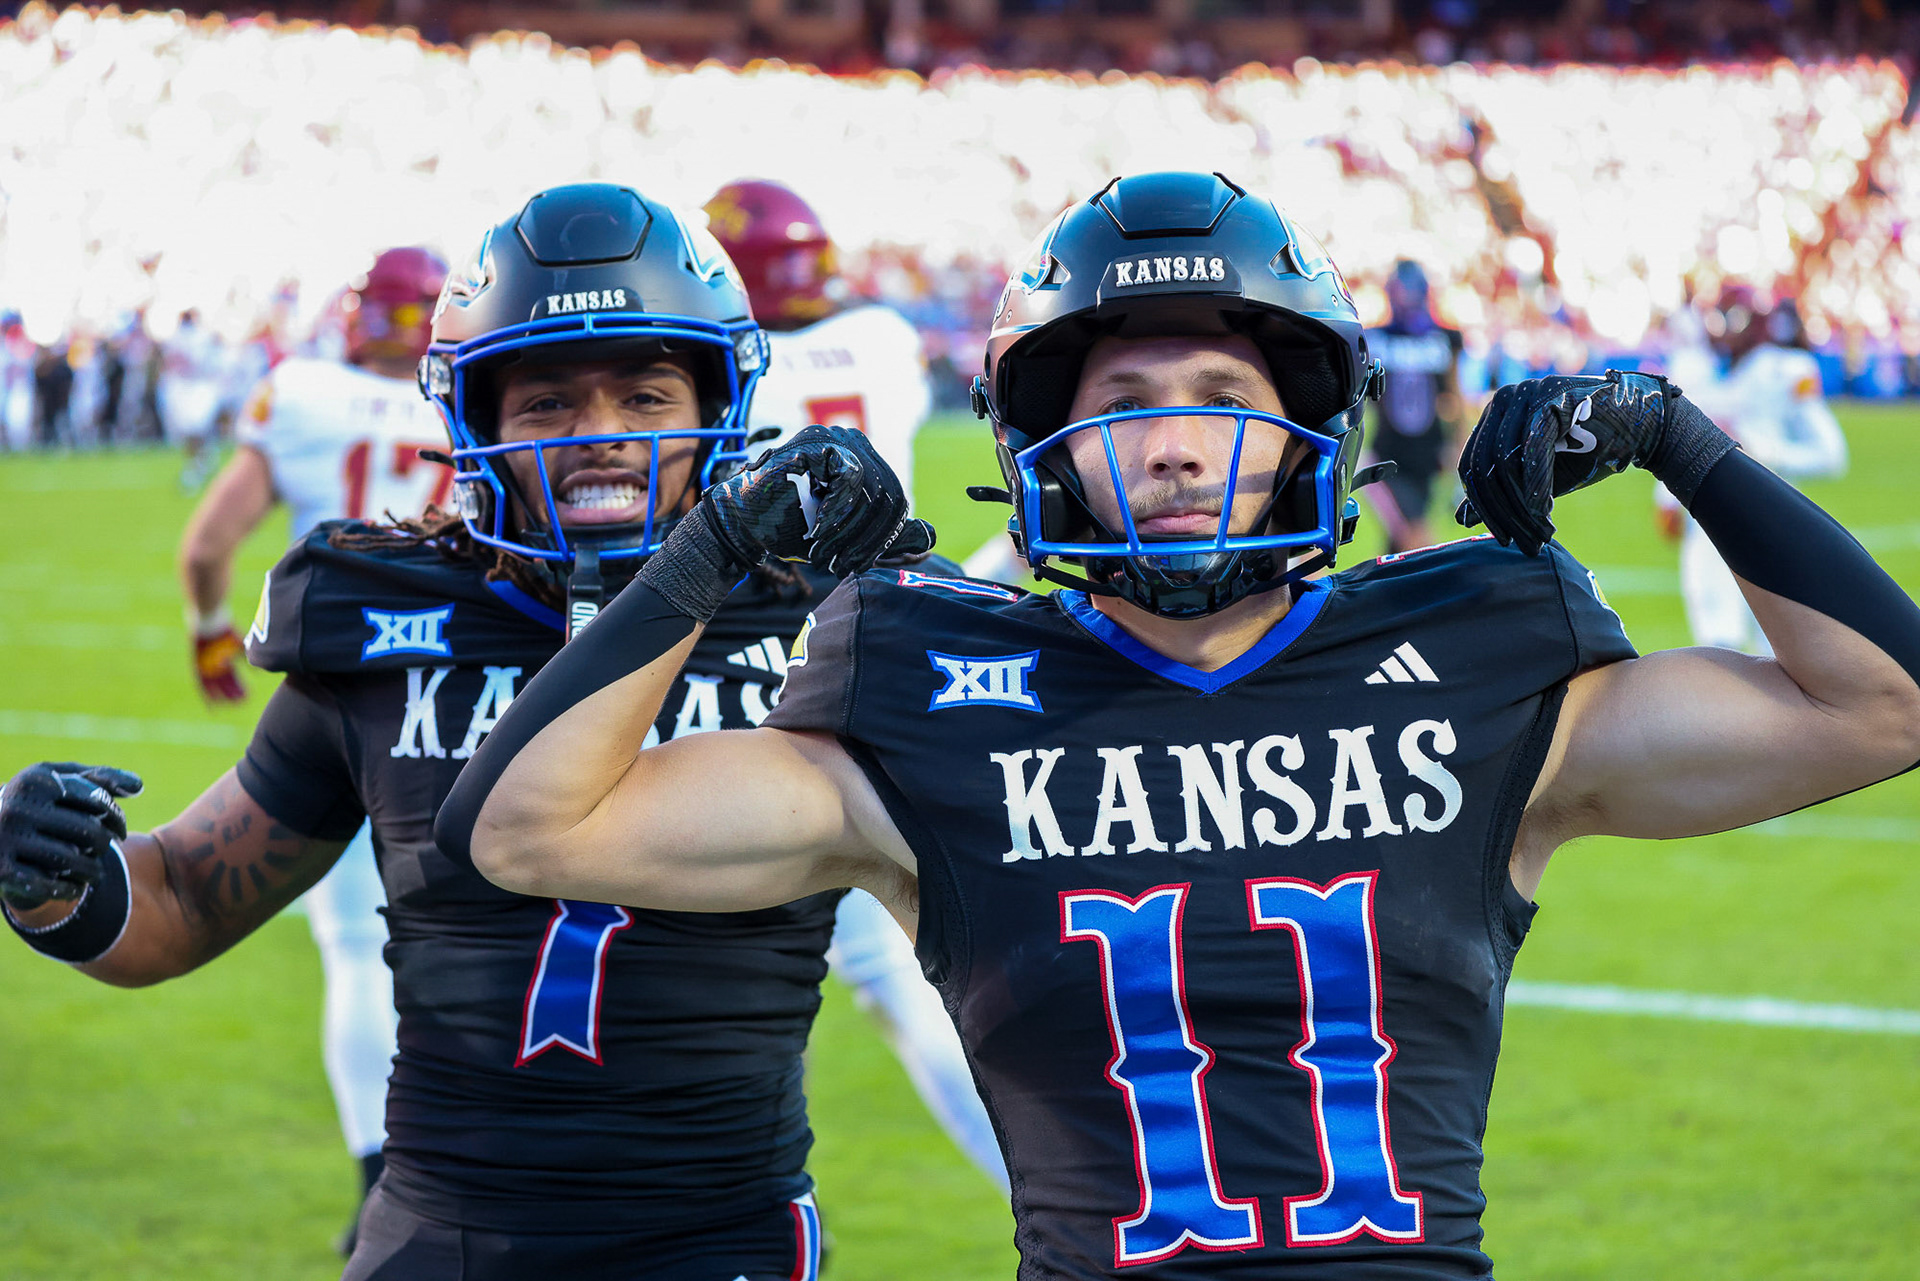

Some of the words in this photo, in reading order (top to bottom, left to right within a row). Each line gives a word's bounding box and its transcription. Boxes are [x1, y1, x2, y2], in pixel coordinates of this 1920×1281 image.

[1115, 256, 1225, 288] KANSAS
[546, 288, 627, 315] KANSAS
[363, 606, 452, 658] XII
[930, 653, 1040, 710] XII
[990, 718, 1462, 863] KANSAS
[1058, 869, 1425, 1268] 11
